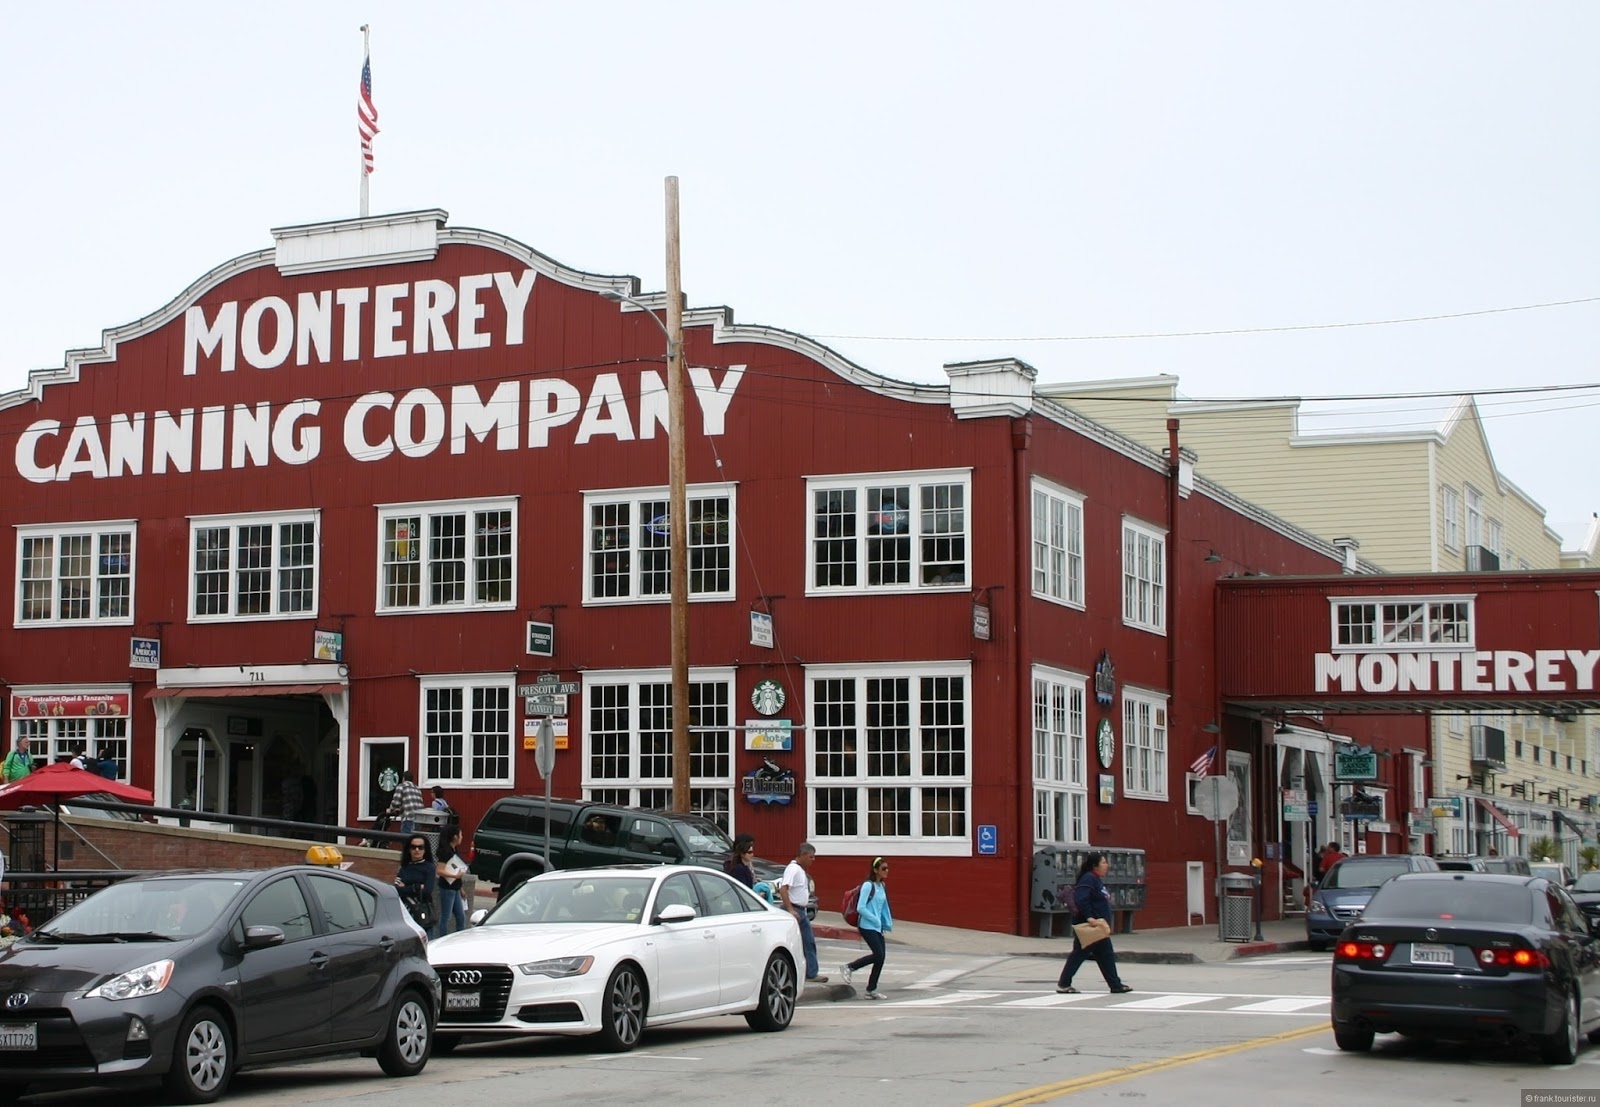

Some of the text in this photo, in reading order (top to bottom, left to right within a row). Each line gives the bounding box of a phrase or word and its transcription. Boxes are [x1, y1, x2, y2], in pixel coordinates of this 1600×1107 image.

[183, 268, 538, 376] MONTEREY
[15, 364, 748, 484] CANNING COMPANY
[249, 672, 265, 681] 711
[1315, 650, 1600, 692] MONTEREY
[520, 685, 557, 695] PRESCOTT
[529, 704, 553, 713] CANNERY
